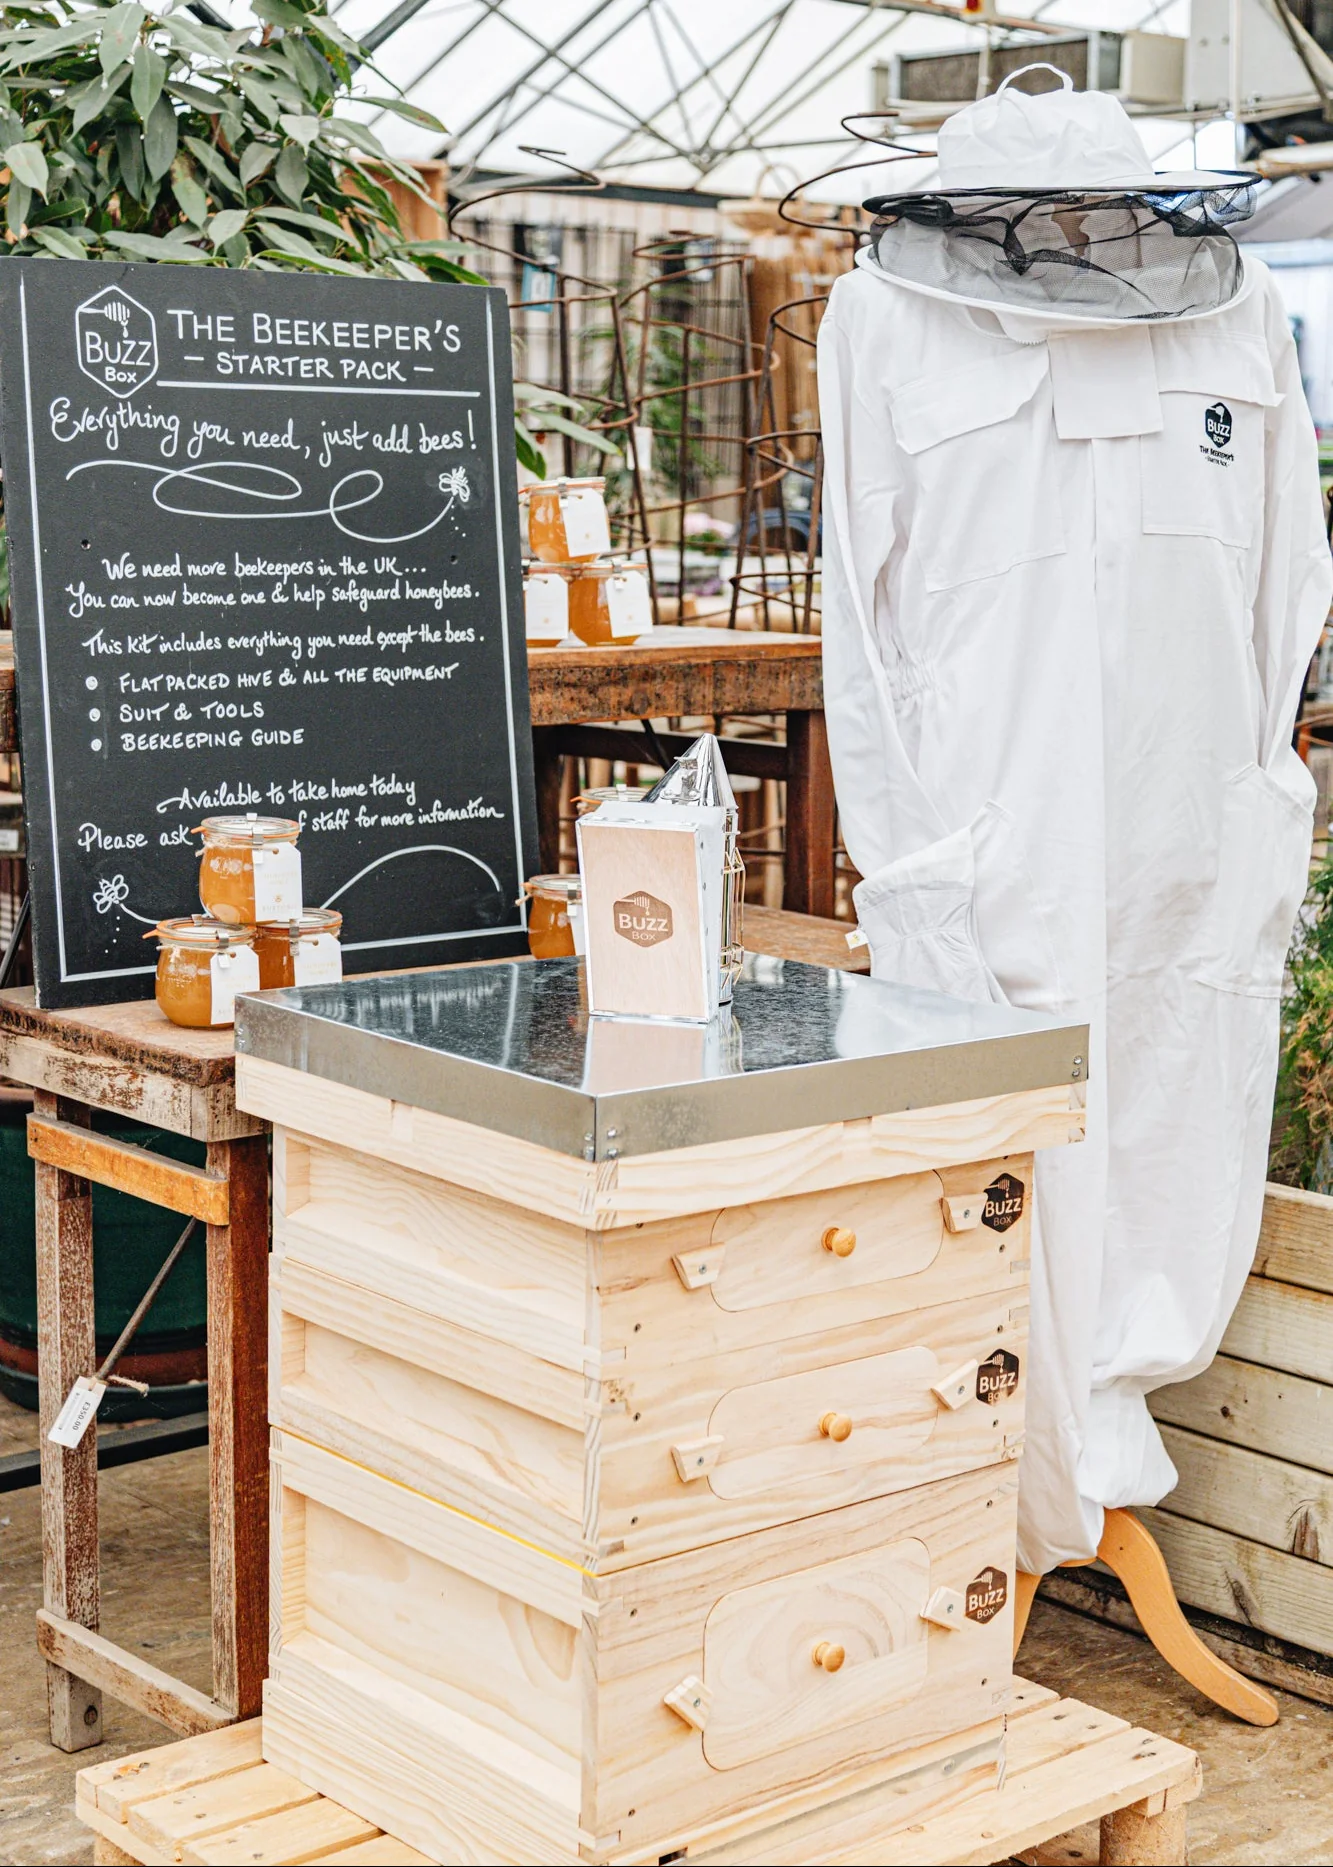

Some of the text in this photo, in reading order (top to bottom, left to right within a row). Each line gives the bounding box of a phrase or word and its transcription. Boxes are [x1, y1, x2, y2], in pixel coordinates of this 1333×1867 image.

[167, 309, 461, 352] THE BEEKEEPER'S
[217, 352, 408, 383] STARTER PACK
[50, 396, 180, 457] Everything
[187, 421, 235, 458] you
[242, 418, 310, 459] need,
[319, 421, 367, 467] just
[373, 424, 413, 453] add
[101, 552, 137, 580] We
[142, 553, 183, 577] need
[187, 562, 226, 576] more
[234, 552, 314, 585] beekeepers
[318, 559, 337, 576] in
[340, 556, 368, 575] the
[65, 579, 479, 618] You can now become one & help safeguard honeybees.
[82, 629, 122, 656] This
[128, 634, 158, 654] kit
[159, 631, 222, 653] includes
[228, 630, 301, 660] everything
[308, 636, 336, 658] you
[339, 625, 374, 645] need
[377, 625, 418, 653] except
[420, 624, 442, 642] the
[166, 673, 230, 692] PACKED
[238, 670, 272, 688] HIVE
[279, 668, 296, 686] &
[303, 670, 329, 684] ALL
[335, 668, 368, 682] THE
[373, 663, 459, 686] EQUIPMENT
[120, 701, 264, 722] SUIT & TOOLS
[121, 729, 304, 751] BEEKEEPING GUIDE
[156, 773, 416, 814] Available to take home today
[78, 823, 148, 852] Please
[159, 824, 193, 846] ask
[312, 808, 349, 831] staff
[355, 805, 378, 827] for
[381, 813, 414, 826] more
